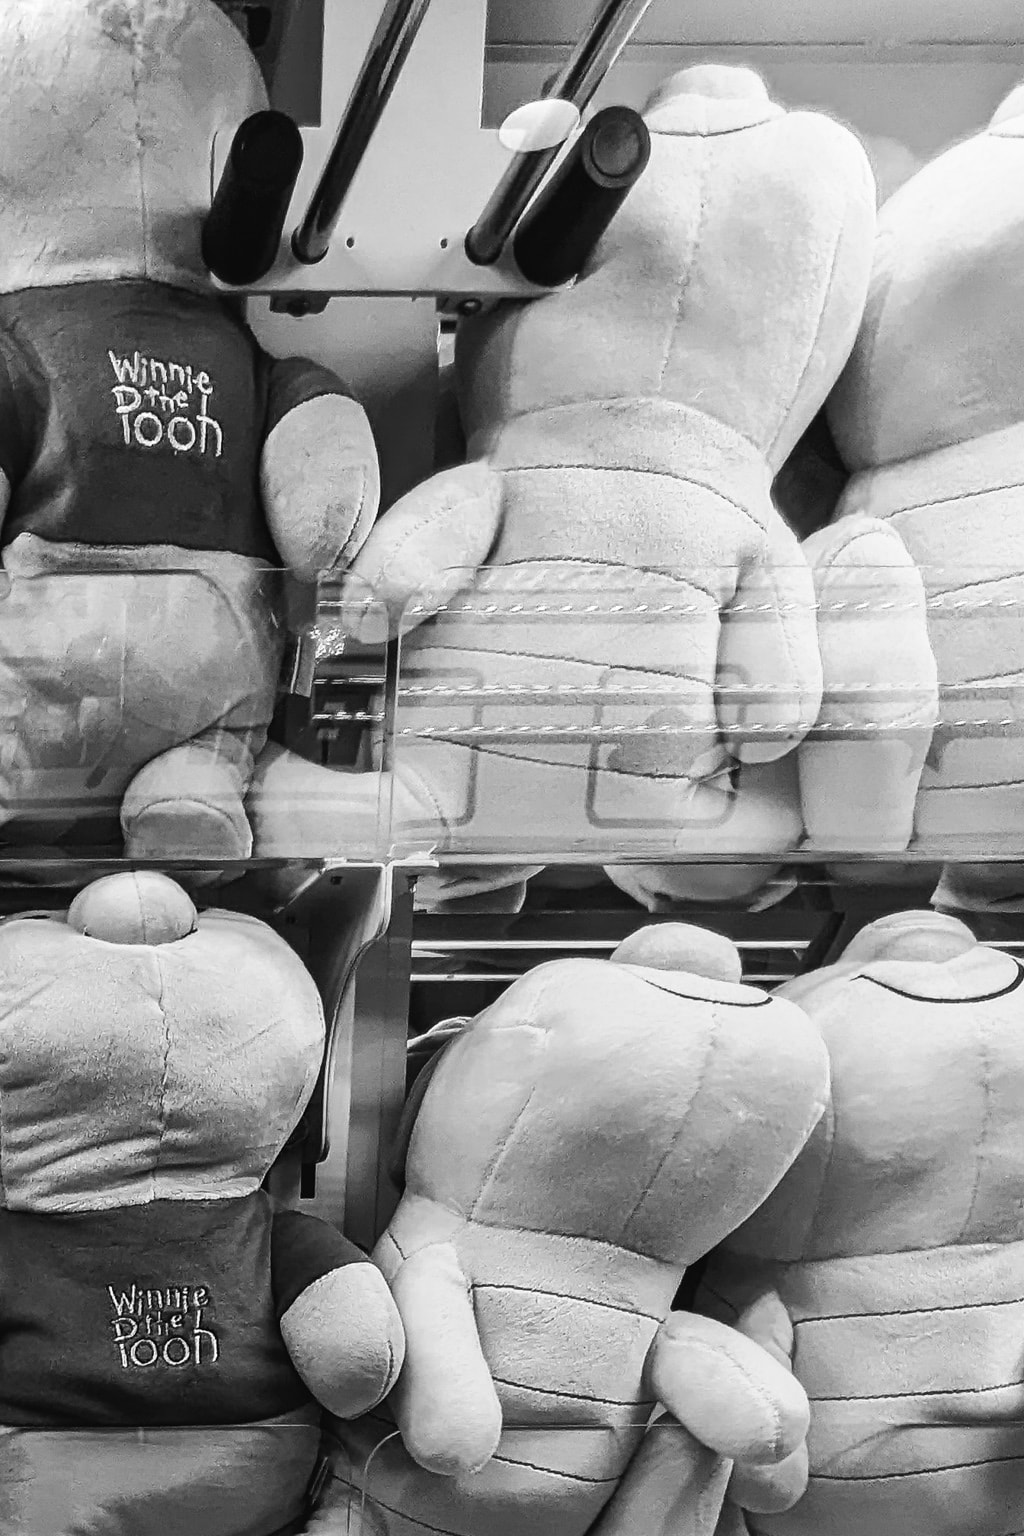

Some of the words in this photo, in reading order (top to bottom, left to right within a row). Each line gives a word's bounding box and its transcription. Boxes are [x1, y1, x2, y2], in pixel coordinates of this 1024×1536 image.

[108, 350, 213, 395] Winnie
[144, 383, 189, 413] the
[111, 385, 222, 457] Pooh
[108, 1283, 209, 1316] Winnie
[111, 1309, 218, 1368] Pooh
[144, 1311, 183, 1336] the
